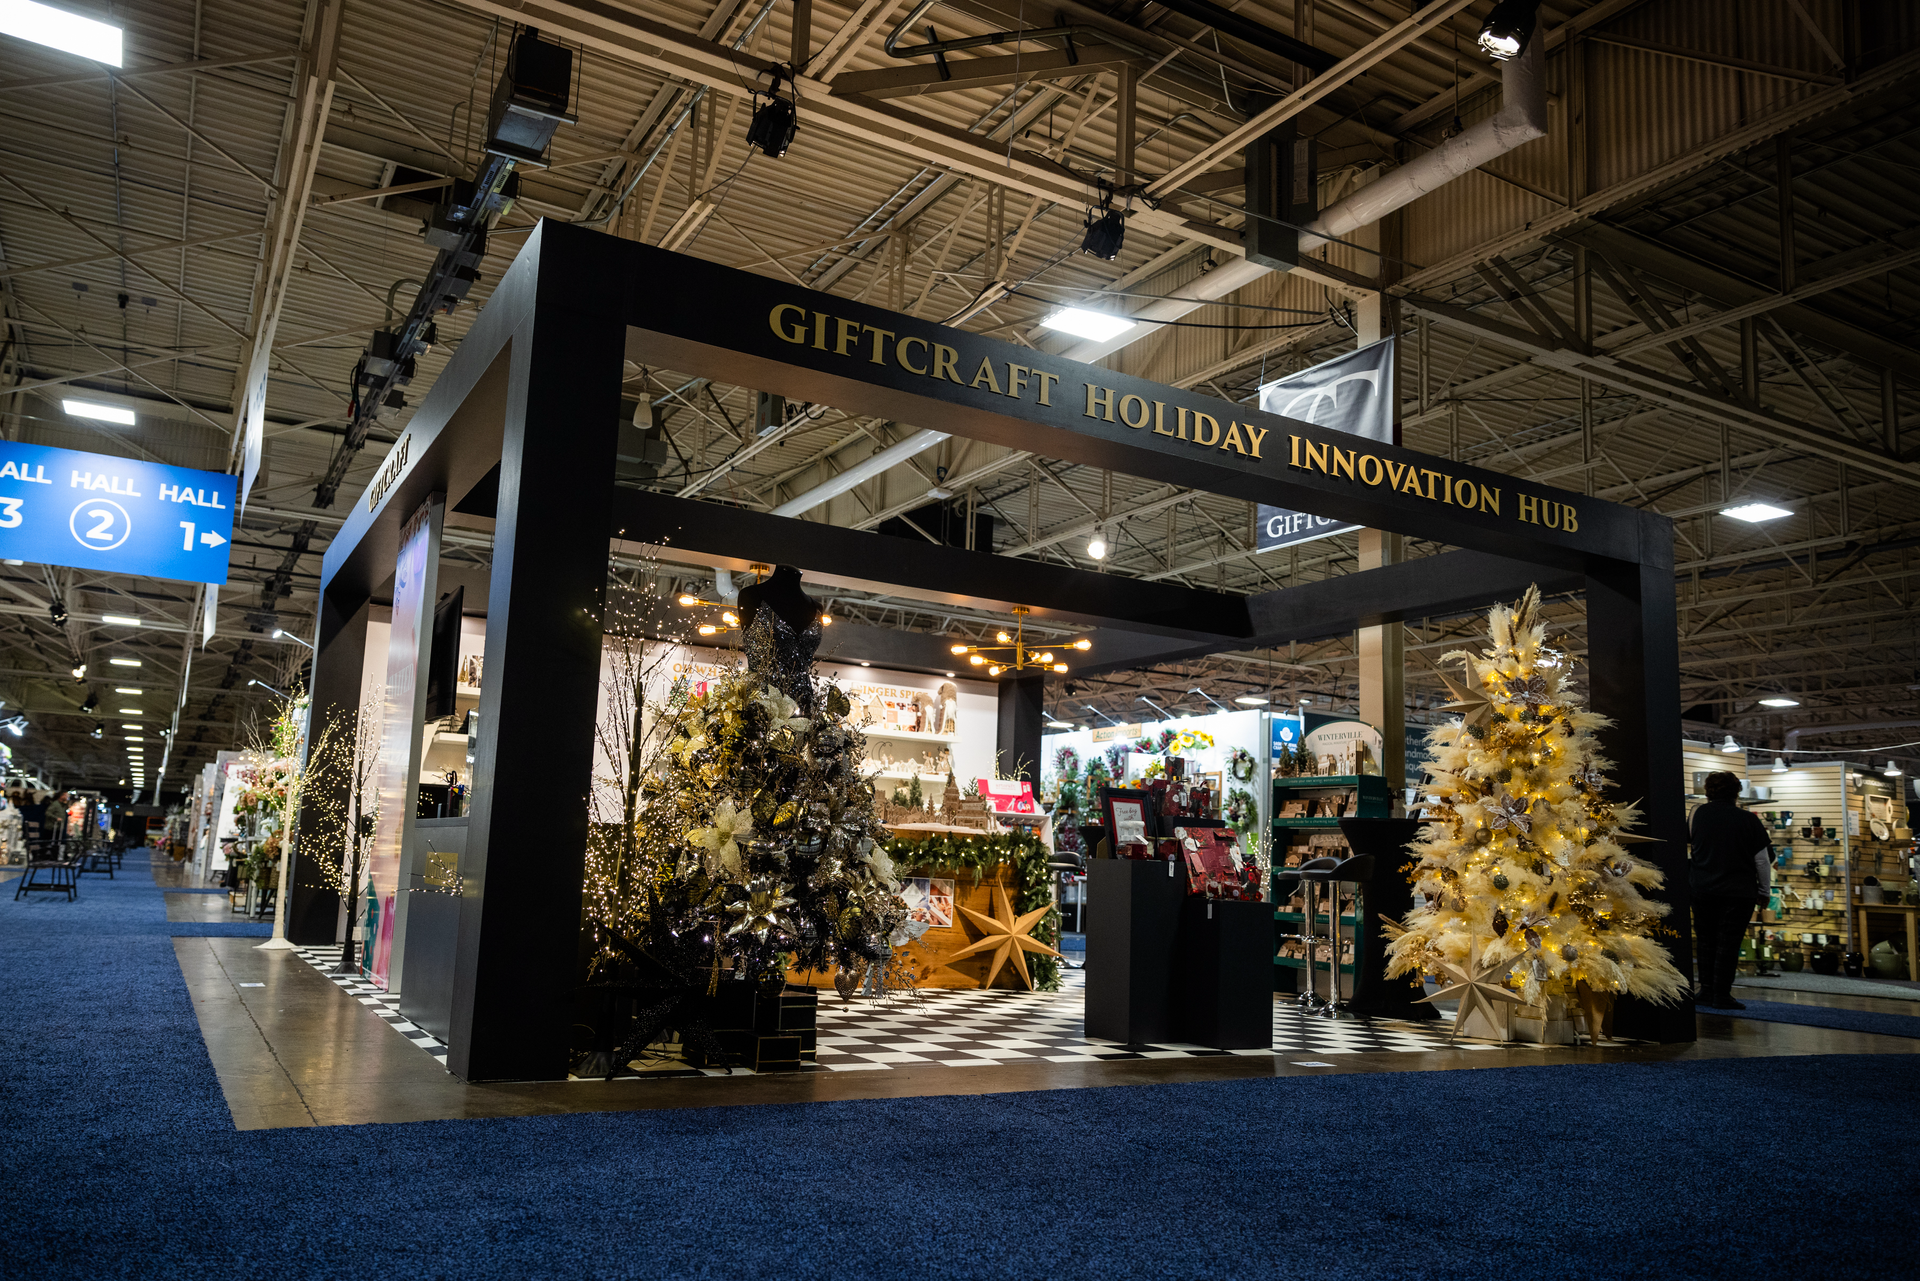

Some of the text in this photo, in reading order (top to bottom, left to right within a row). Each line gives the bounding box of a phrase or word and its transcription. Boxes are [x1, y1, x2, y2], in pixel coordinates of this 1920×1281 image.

[769, 303, 1580, 534] GIFTCRAFT HOLIDAY INNOVATION HUB
[0, 461, 226, 509] ALL HALL HALL
[0, 496, 196, 552] 3 2 1
[1266, 512, 1338, 538] GIFT
[859, 684, 898, 698] INGER
[1317, 731, 1363, 741] WINTERVILLE
